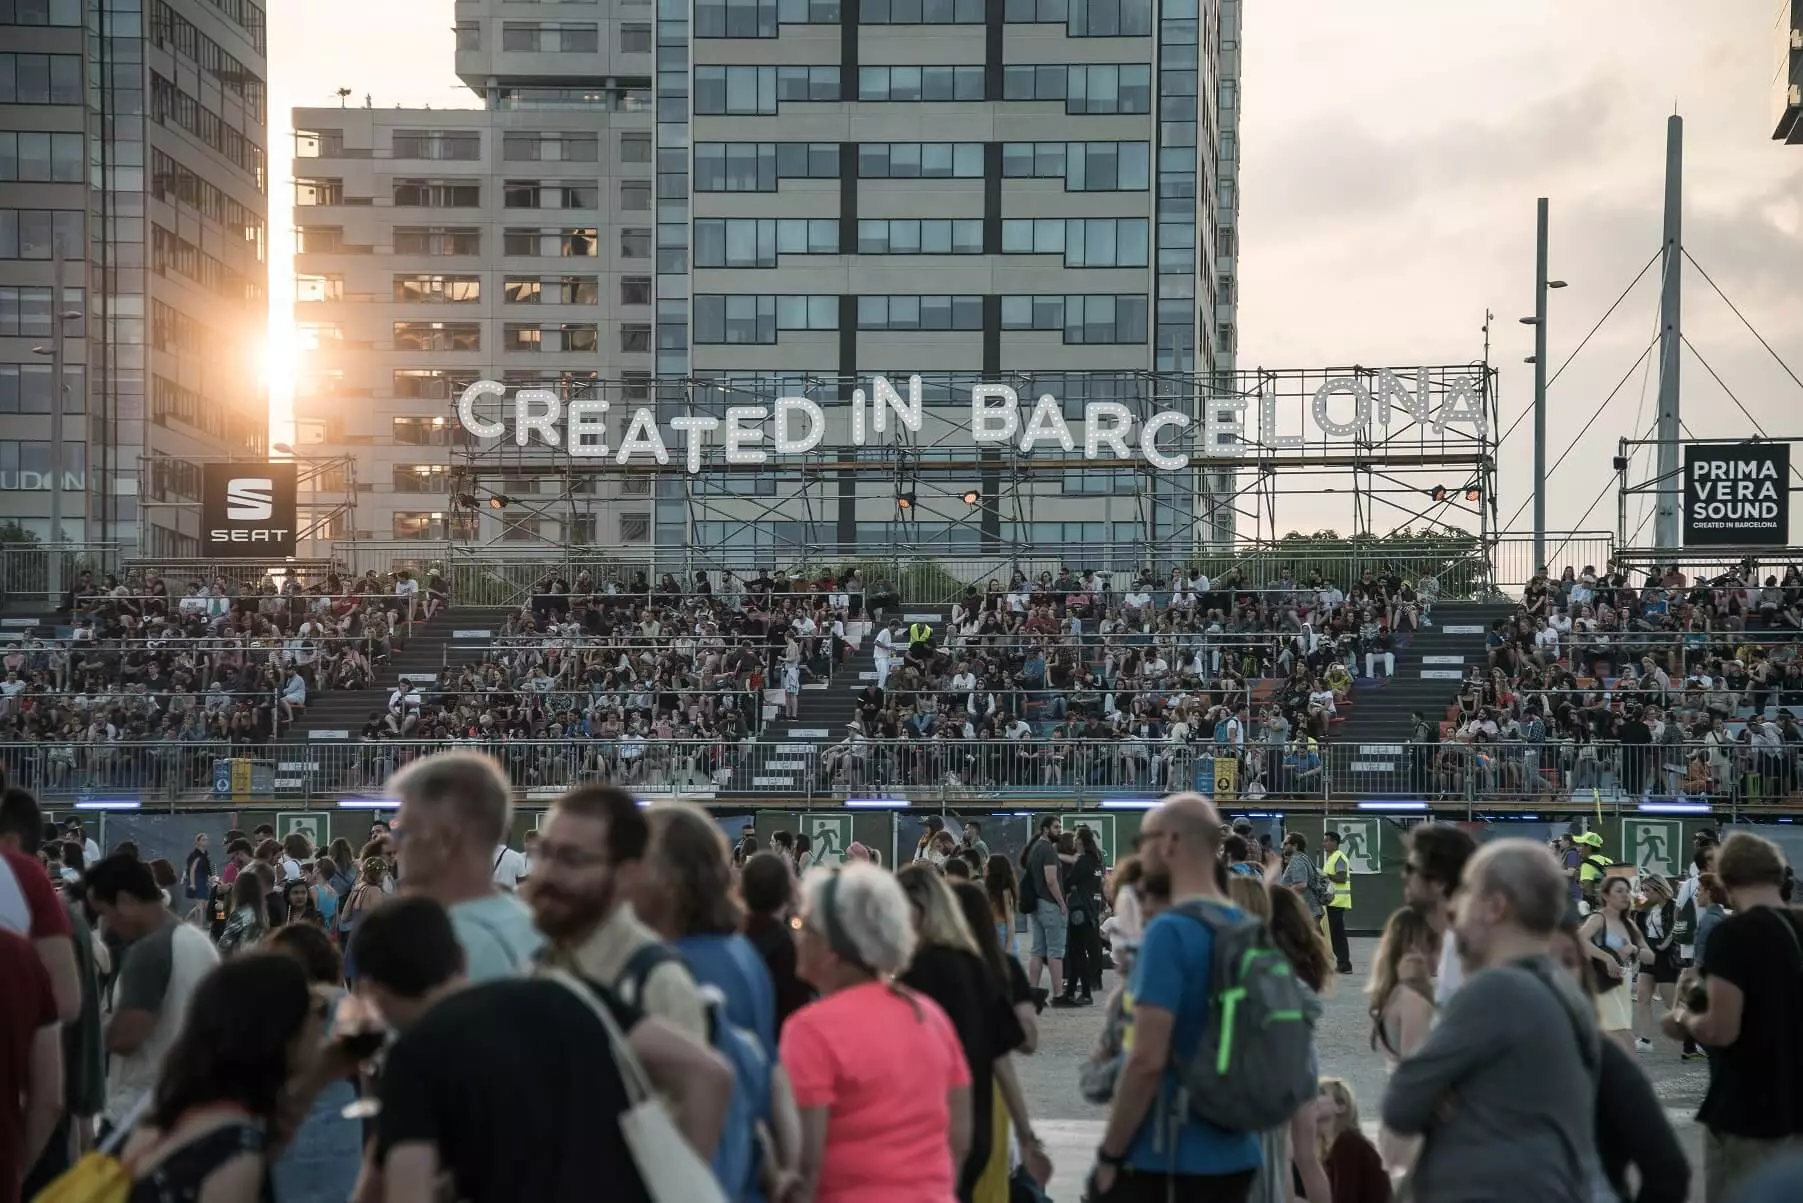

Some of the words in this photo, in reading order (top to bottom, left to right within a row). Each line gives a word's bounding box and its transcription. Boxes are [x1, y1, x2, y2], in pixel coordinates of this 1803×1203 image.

[457, 380, 826, 474] CREATED
[852, 374, 922, 446] IN
[971, 366, 1490, 471] BARCELONA
[1693, 460, 1778, 479] PRIMA
[1693, 481, 1778, 500] VERA
[1693, 502, 1778, 519] SOUND
[1693, 521, 1725, 529] CREATED
[210, 529, 289, 542] SEAT
